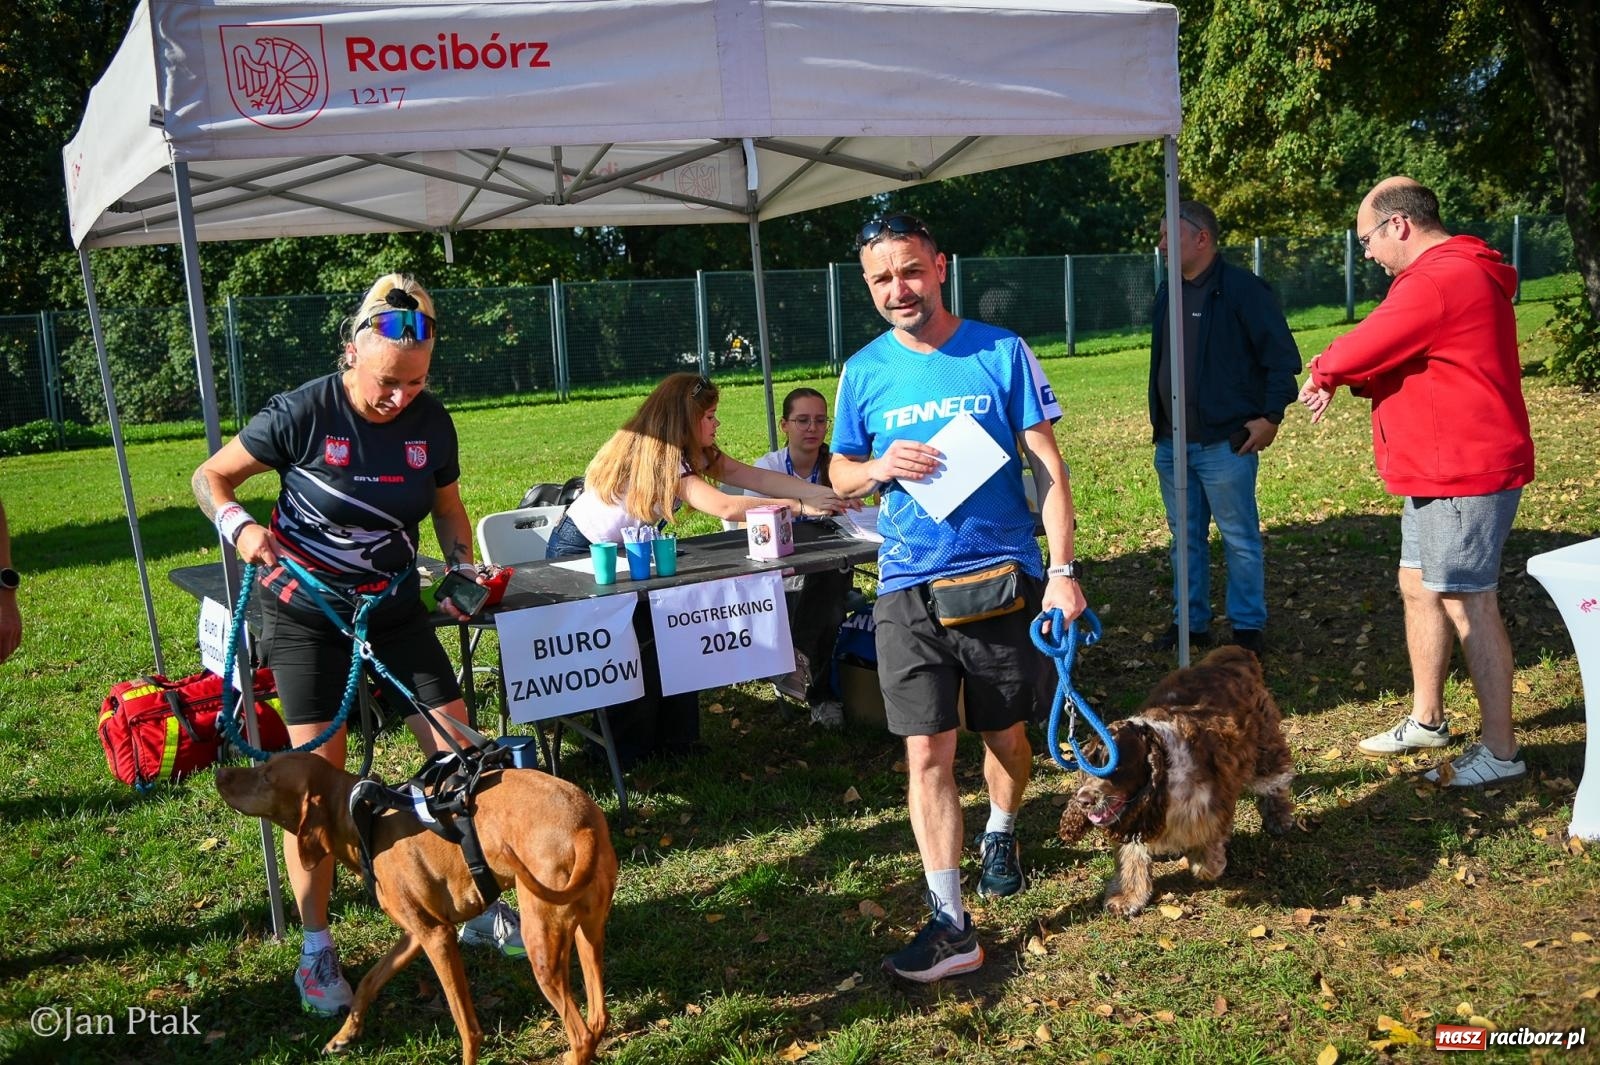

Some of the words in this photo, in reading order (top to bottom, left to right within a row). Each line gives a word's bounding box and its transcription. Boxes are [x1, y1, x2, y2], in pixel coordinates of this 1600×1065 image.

[345, 33, 551, 72] Racibórz
[349, 87, 406, 109] 1217
[882, 394, 993, 430] TENNECO
[667, 598, 774, 629] DOGTREKKING
[533, 628, 612, 660] BIURO
[700, 628, 752, 655] 2026
[511, 658, 639, 702] ZAWODÓW
